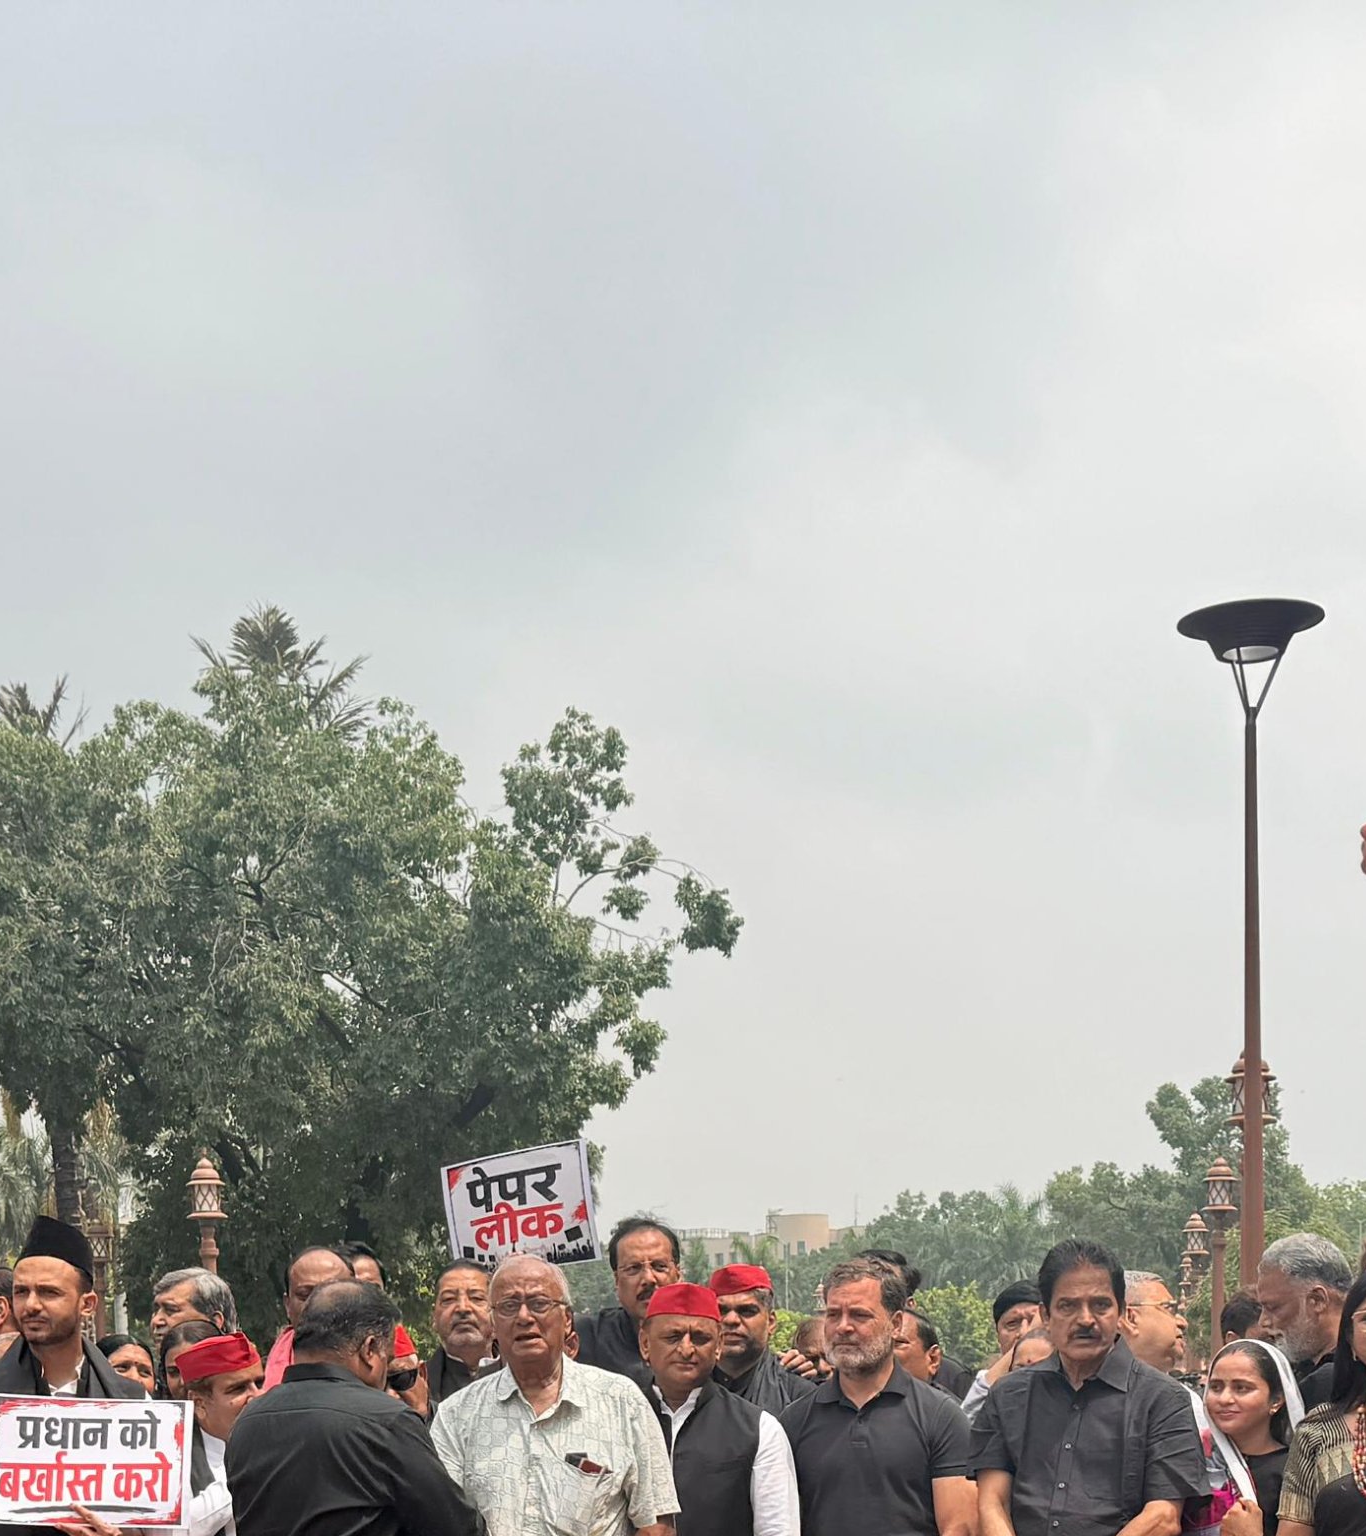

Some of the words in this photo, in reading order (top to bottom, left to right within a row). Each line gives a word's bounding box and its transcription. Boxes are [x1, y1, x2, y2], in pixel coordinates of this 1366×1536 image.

[465, 1162, 562, 1213] पेपर
[469, 1201, 564, 1251] लीक
[16, 1415, 113, 1450] प्रधान
[118, 1409, 162, 1450] को
[112, 1450, 173, 1503] करो
